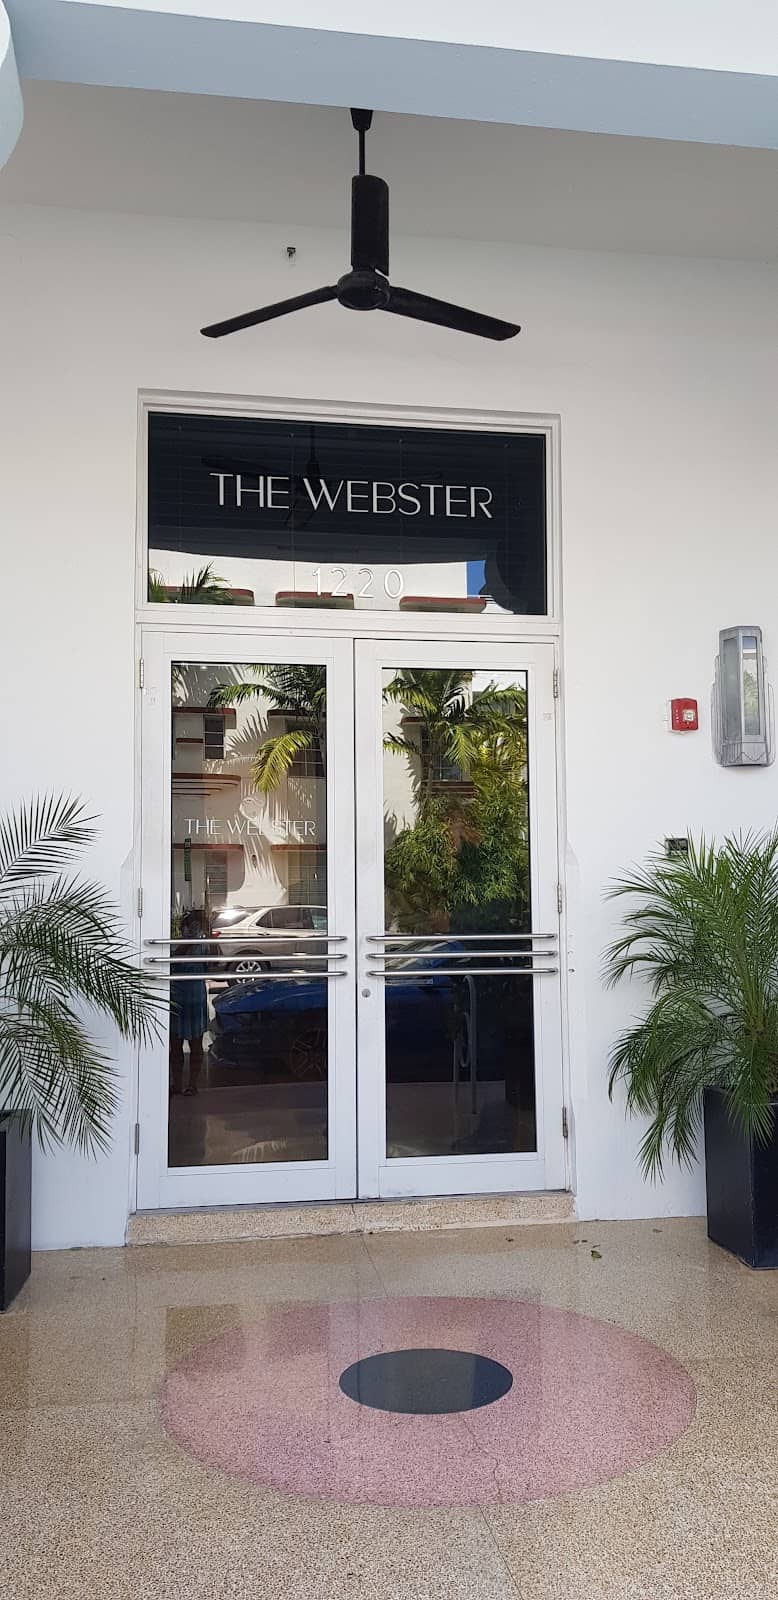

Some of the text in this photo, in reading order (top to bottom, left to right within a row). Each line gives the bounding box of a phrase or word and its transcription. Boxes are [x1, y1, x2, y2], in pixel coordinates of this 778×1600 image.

[209, 472, 493, 519] THE WEBSTER
[311, 566, 405, 600] 1220
[184, 818, 222, 835] THE
